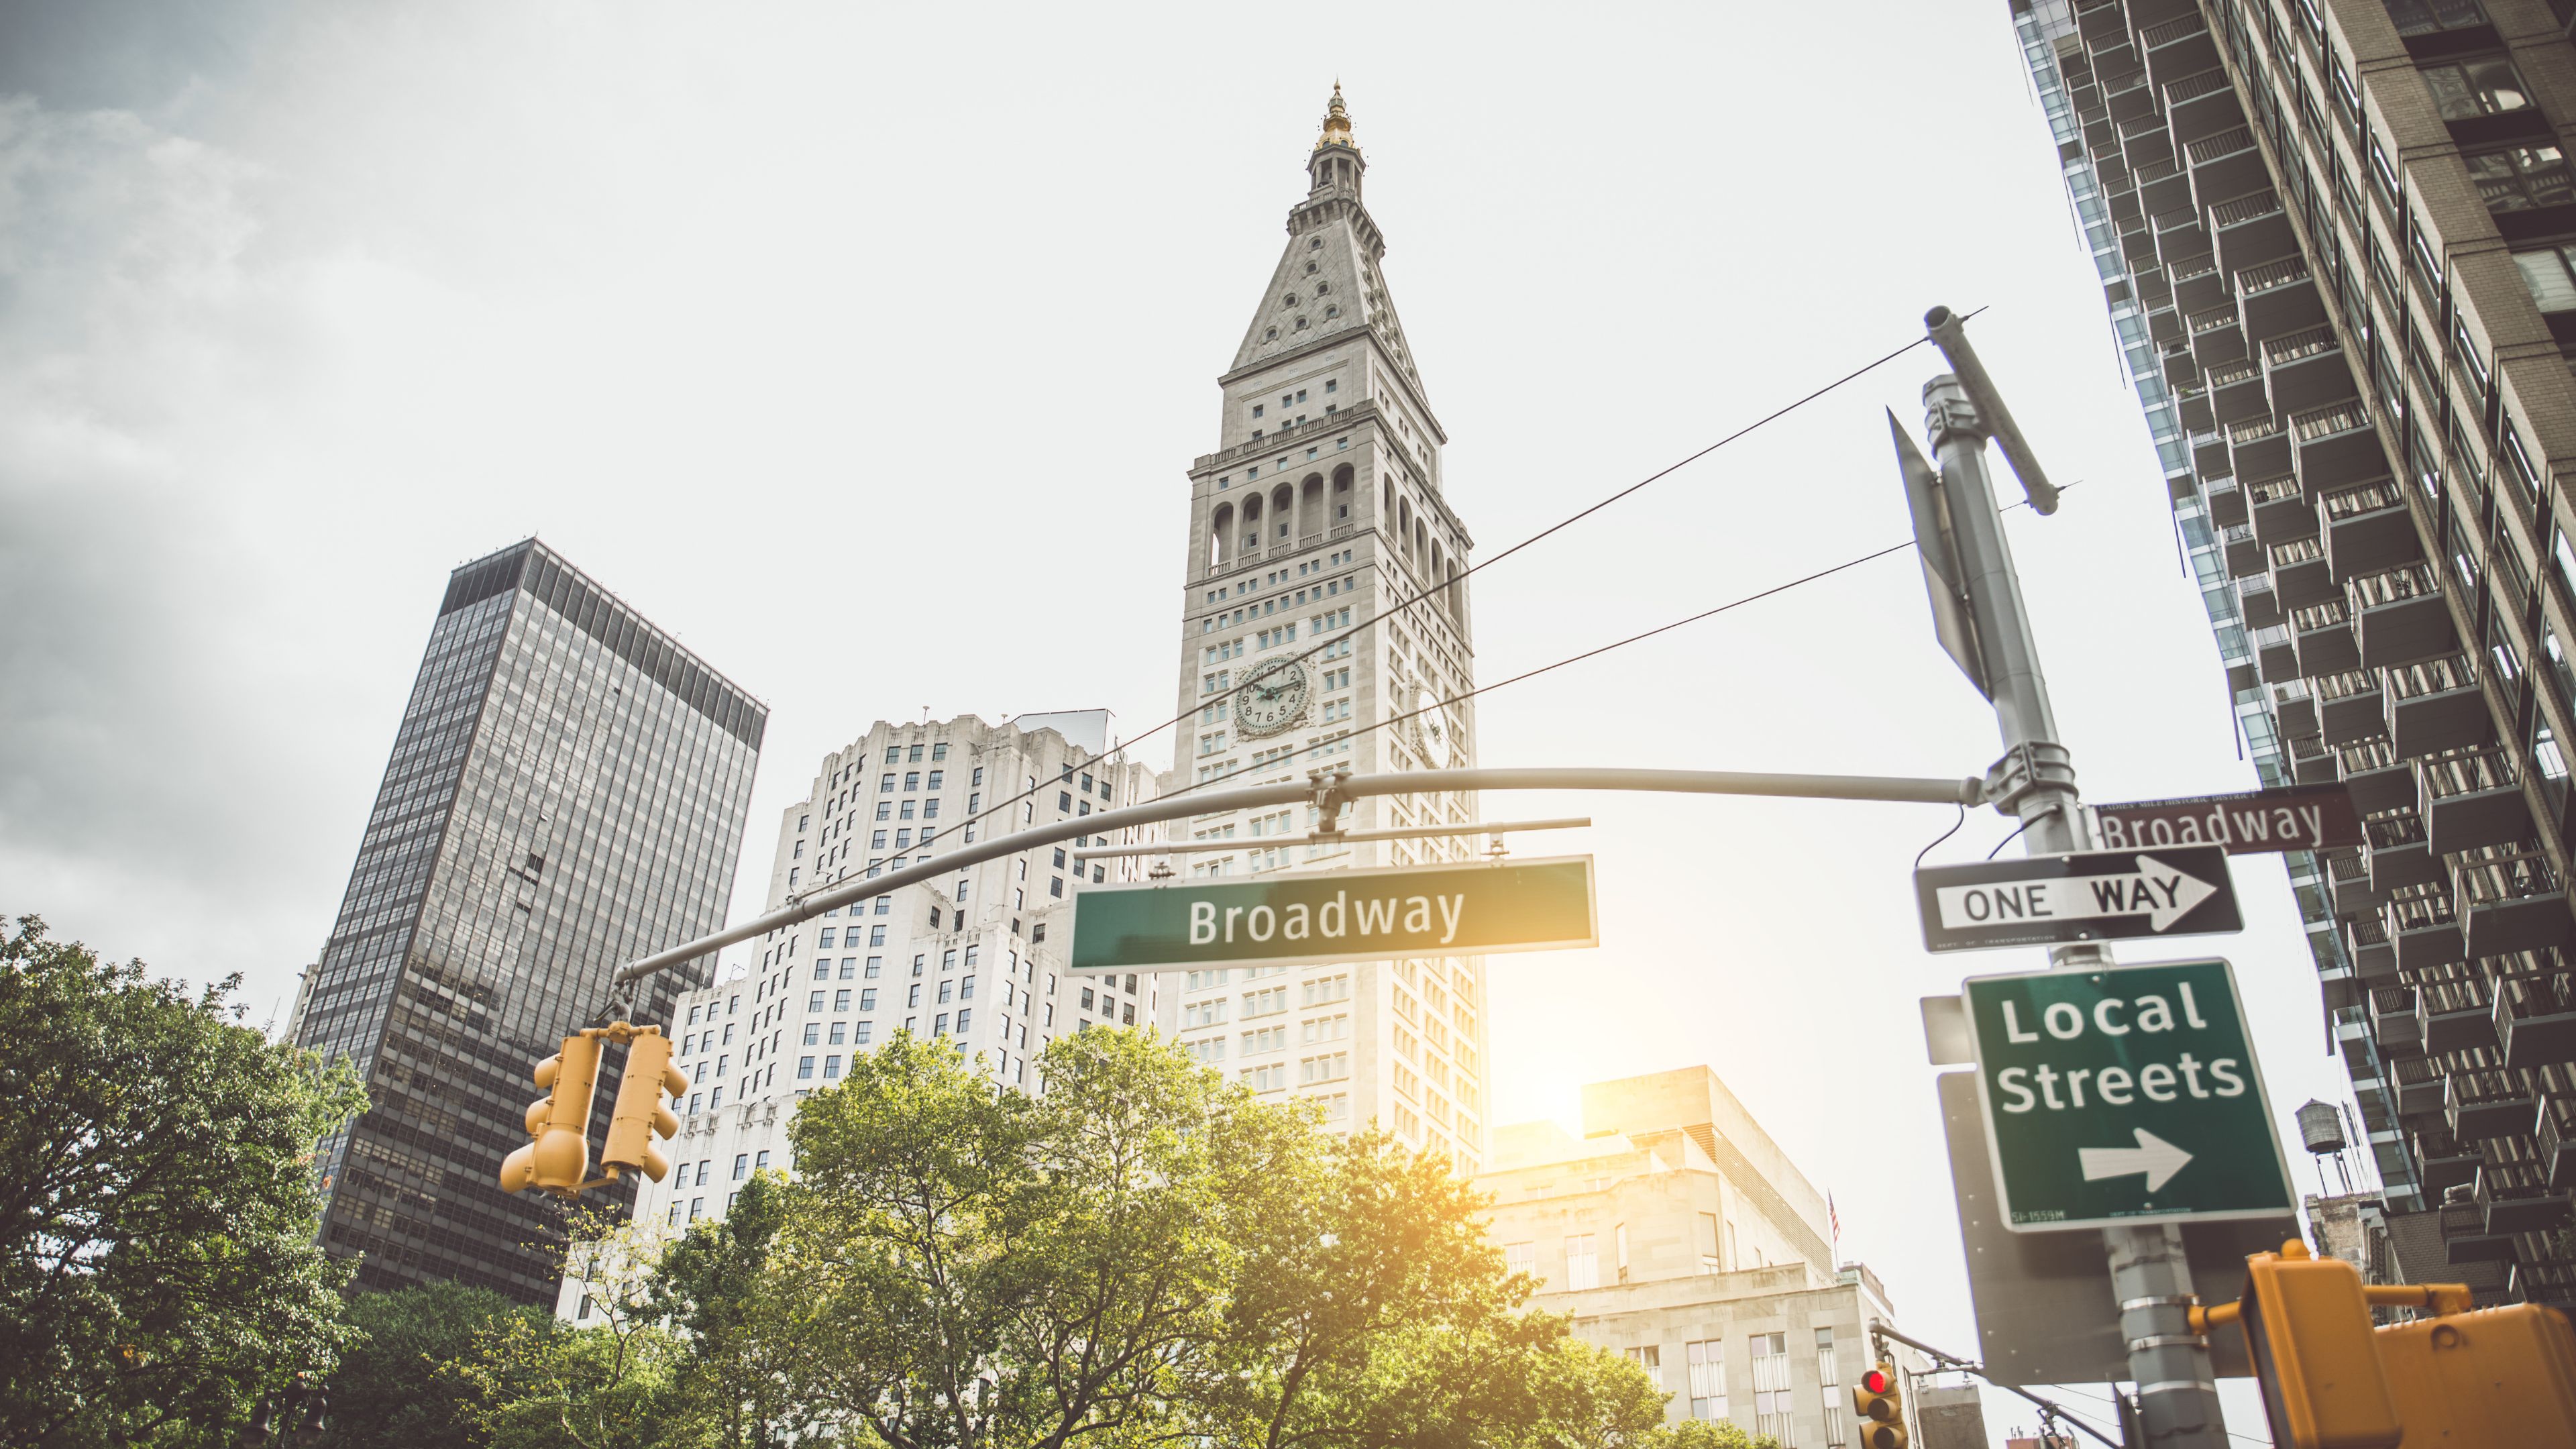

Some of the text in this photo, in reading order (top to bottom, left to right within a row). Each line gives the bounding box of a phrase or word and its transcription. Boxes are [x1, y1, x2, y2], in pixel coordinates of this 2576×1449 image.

[1290, 671, 1297, 681] 2
[1246, 683, 1256, 694] 10
[1242, 696, 1250, 705] 9
[1289, 694, 1296, 704] 4
[1245, 706, 1252, 716] 8
[1279, 705, 1286, 716] 5
[1254, 711, 1262, 722] 7
[1267, 712, 1274, 722] 6
[2139, 799, 2163, 808] MILE
[2165, 796, 2208, 806] HISTORIC
[2212, 792, 2256, 802] DISTRICT
[2101, 804, 2322, 848] Broadway
[1964, 875, 2181, 922] ONE WAY
[1188, 890, 1464, 945] Broadway
[1984, 935, 2055, 945] TRANSPORTATION
[2001, 981, 2207, 1043] Local
[1997, 1053, 2246, 1113] Streets
